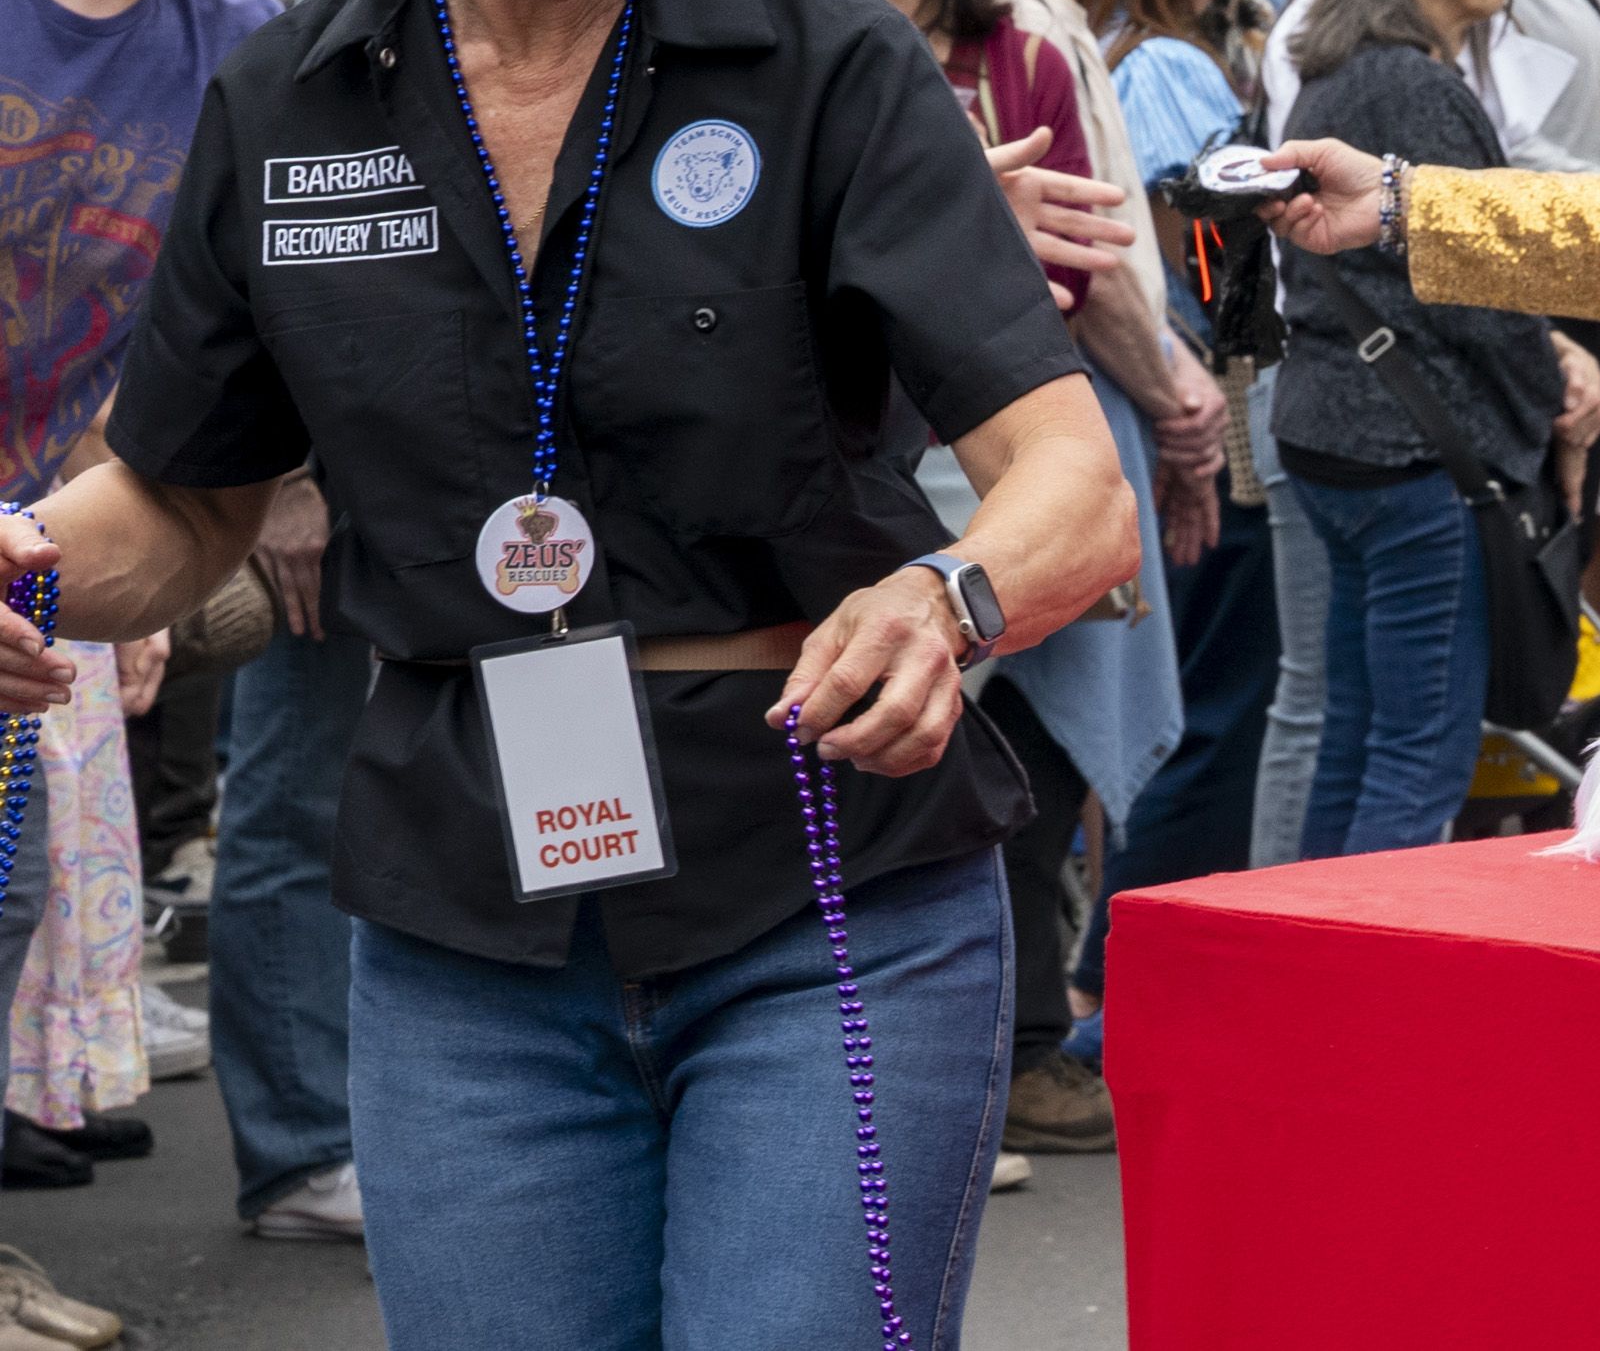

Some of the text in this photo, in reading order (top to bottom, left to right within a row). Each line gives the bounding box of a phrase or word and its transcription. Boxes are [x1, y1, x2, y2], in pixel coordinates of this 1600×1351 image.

[673, 128, 743, 150] TEAM SCRIM
[288, 153, 416, 194] BARBARA
[696, 186, 747, 218] RESCUES
[275, 215, 429, 256] RECOVERY TEAM
[504, 542, 583, 569] ZEUS'
[509, 569, 568, 583] RESCUES
[536, 797, 632, 834] ROYAL
[540, 830, 639, 868] COURT
